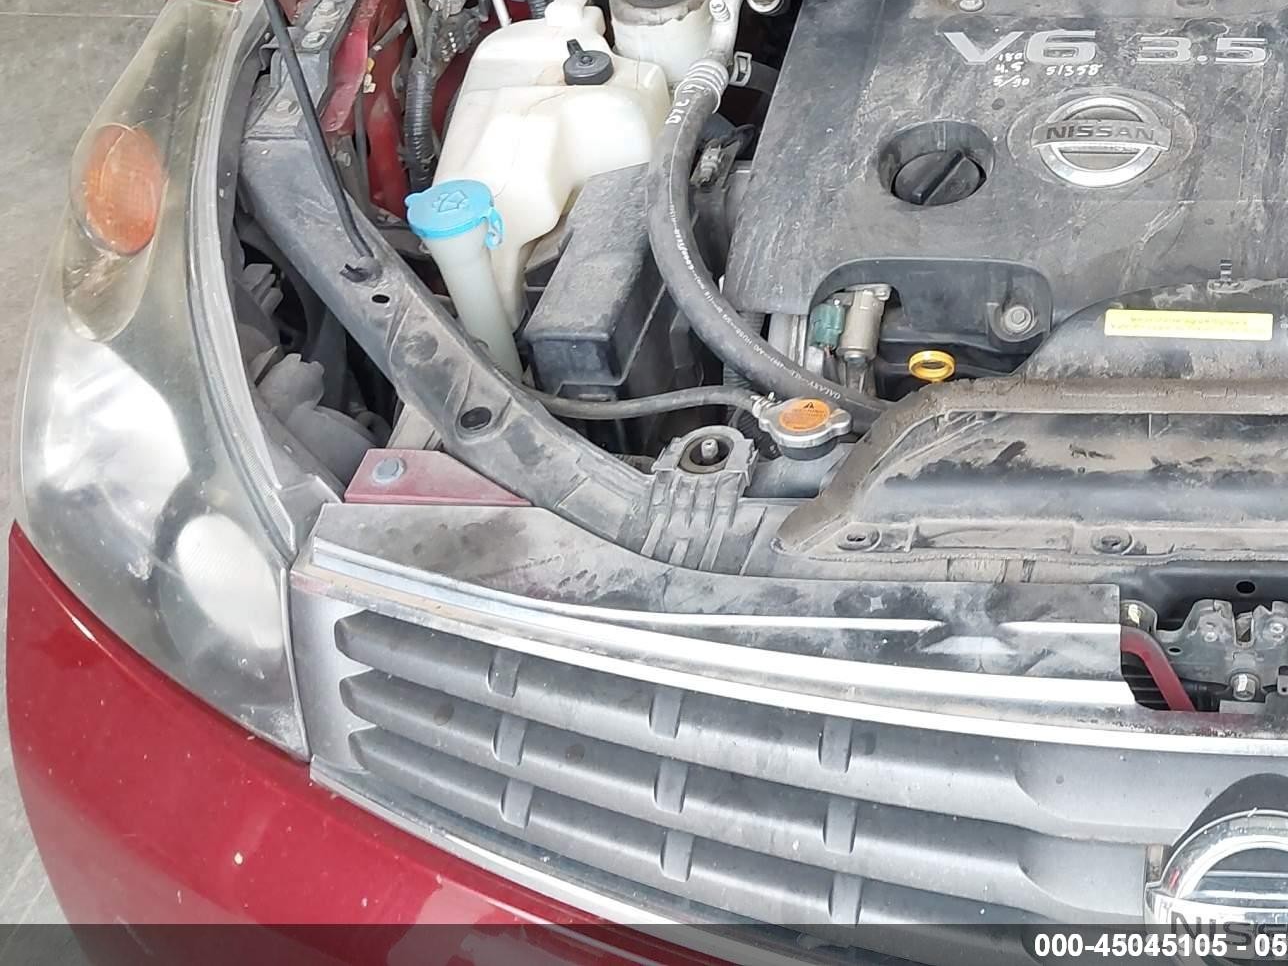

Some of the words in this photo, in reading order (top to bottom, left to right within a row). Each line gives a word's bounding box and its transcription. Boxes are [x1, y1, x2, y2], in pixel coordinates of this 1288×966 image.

[943, 30, 1097, 64] V6
[1136, 36, 1269, 65] 3.5
[1046, 125, 1154, 141] NISSAN
